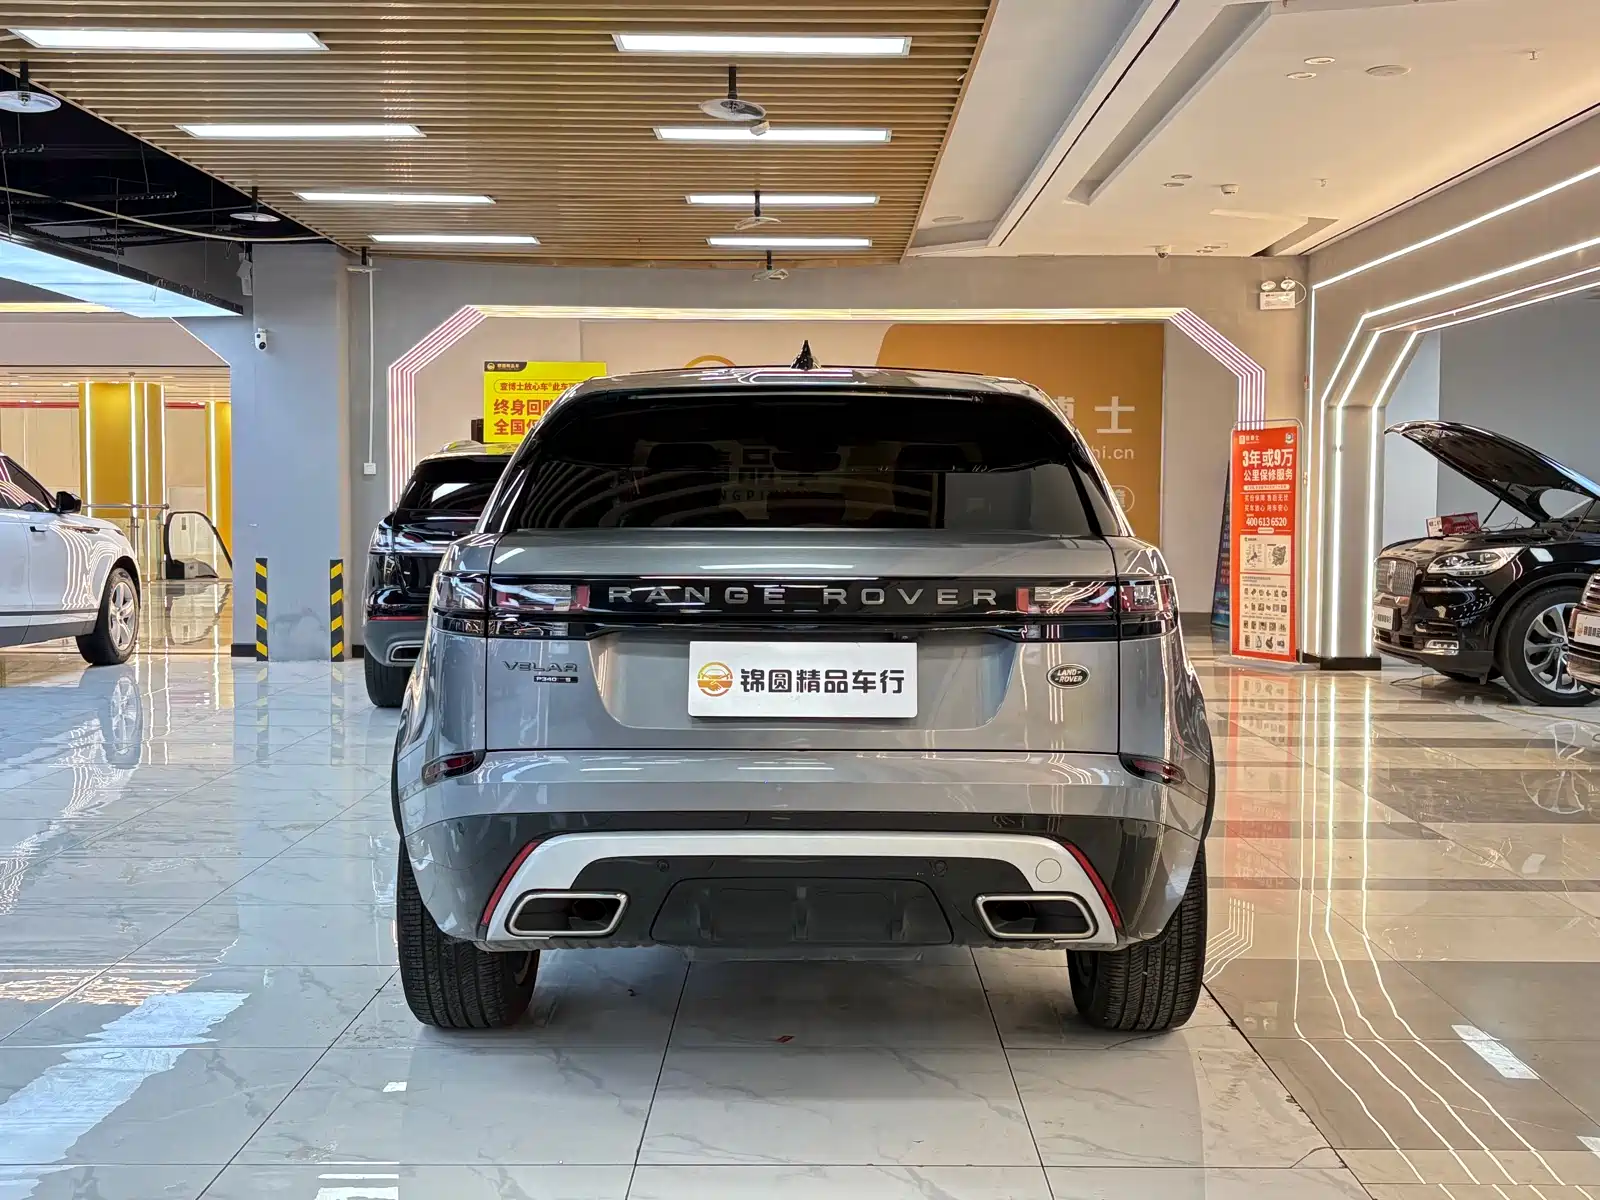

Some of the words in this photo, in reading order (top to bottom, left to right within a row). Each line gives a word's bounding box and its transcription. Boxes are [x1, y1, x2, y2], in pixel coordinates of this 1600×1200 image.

[1242, 448, 1294, 468] 3年或9万
[1243, 468, 1293, 482] 公里保修服务
[1246, 517, 1258, 527] 400
[1258, 517, 1270, 527] 613
[1270, 516, 1288, 527] 6520
[608, 586, 786, 605] RANGE
[822, 588, 997, 606] ROVER
[502, 660, 579, 673] VELAR
[740, 668, 905, 694] 锦圆精品车行
[1059, 675, 1083, 683] ROVER
